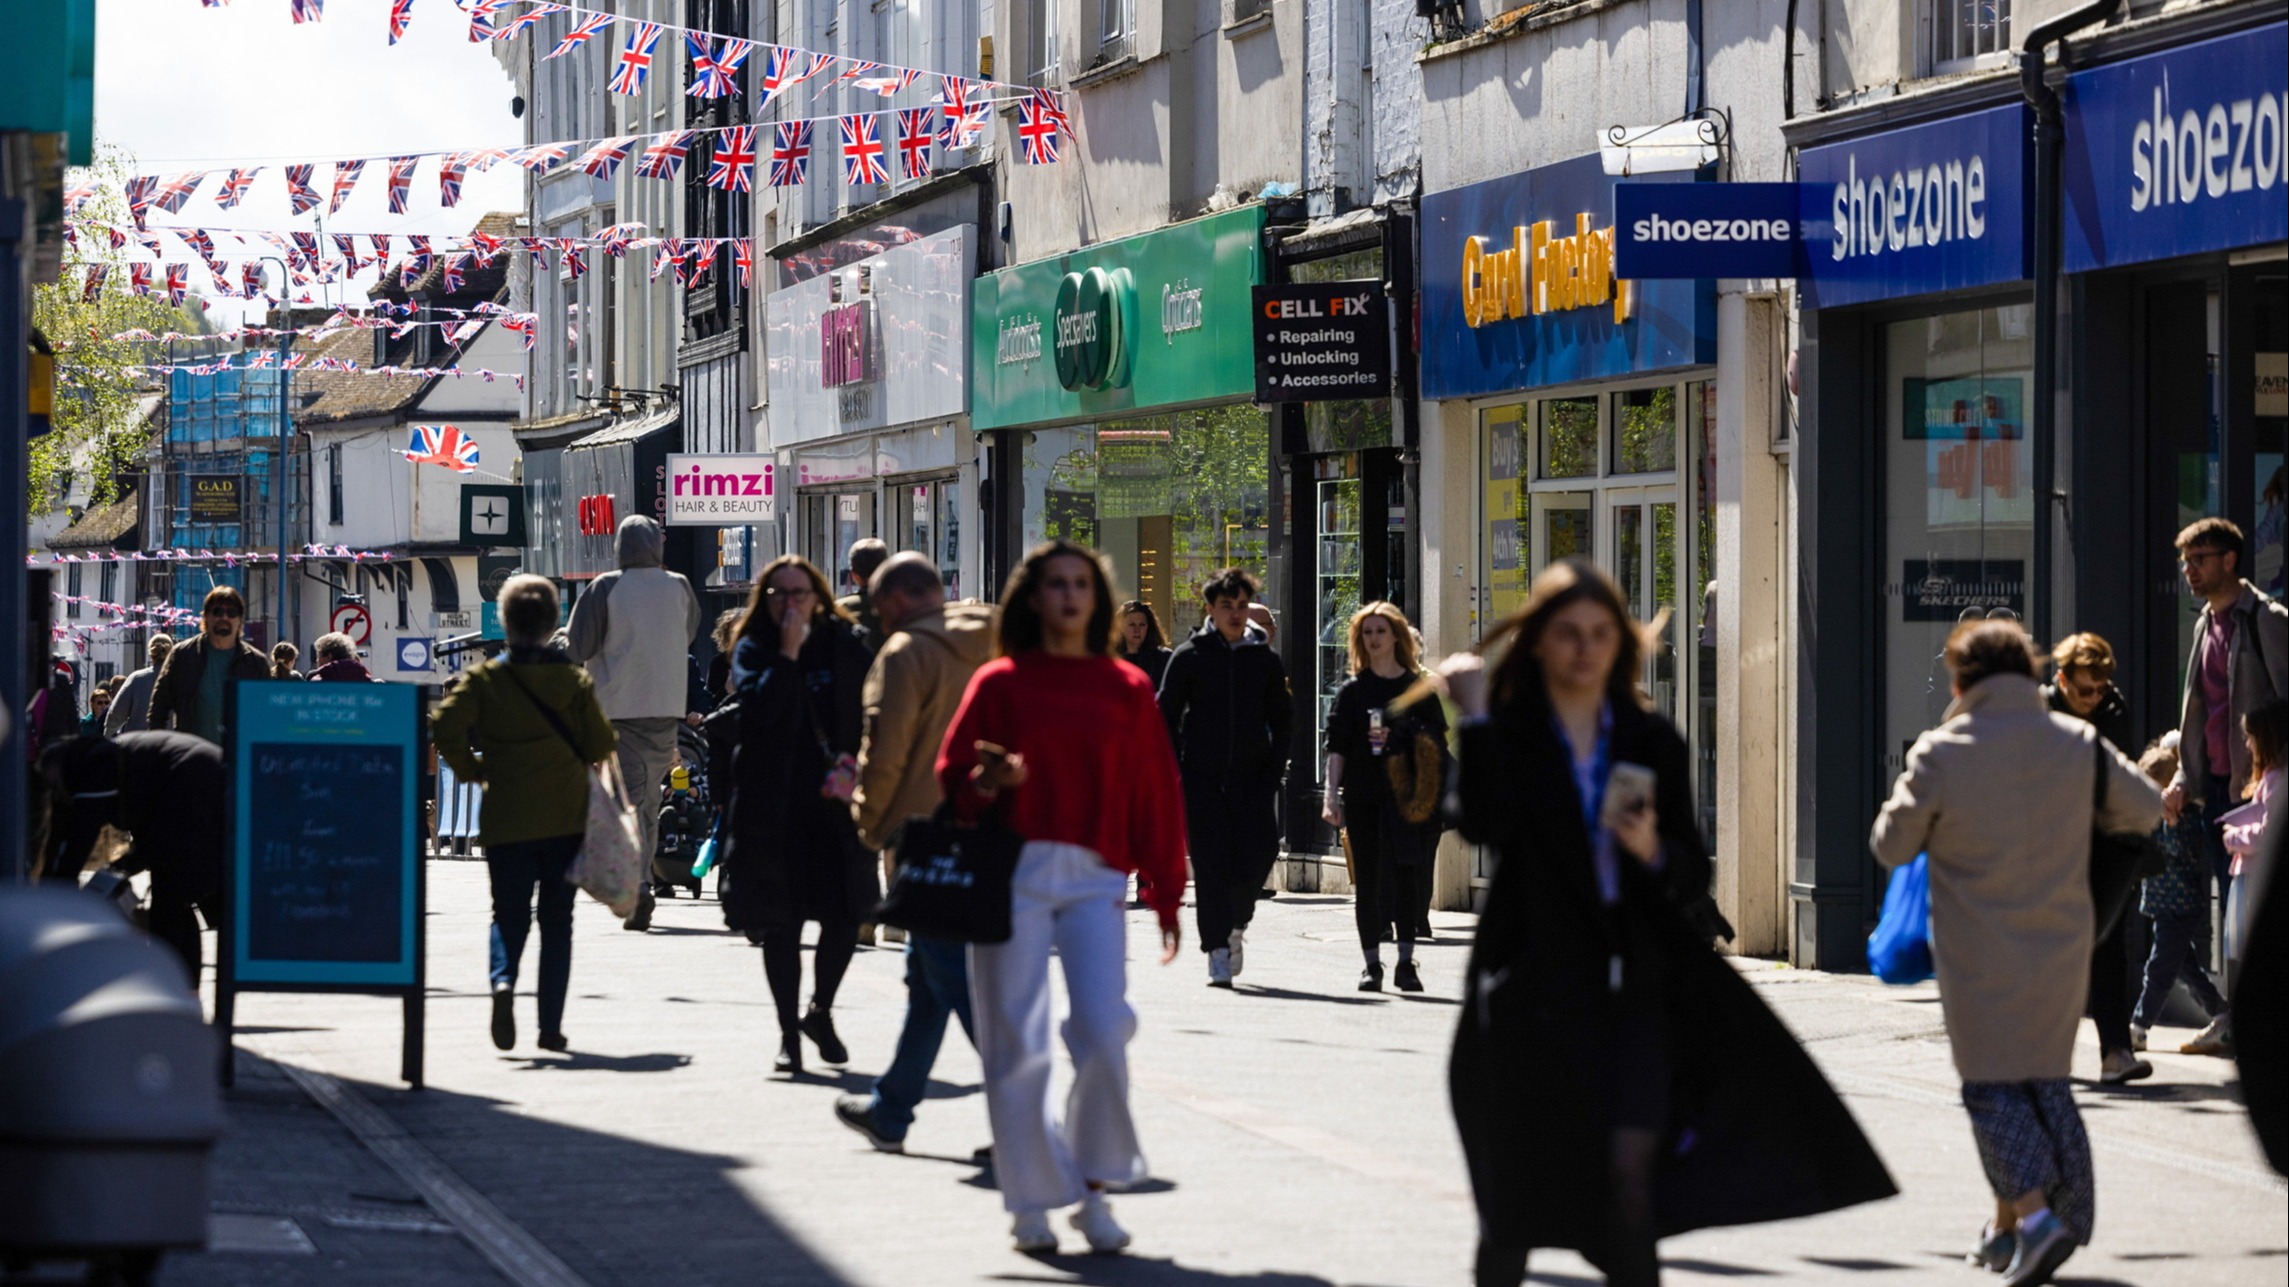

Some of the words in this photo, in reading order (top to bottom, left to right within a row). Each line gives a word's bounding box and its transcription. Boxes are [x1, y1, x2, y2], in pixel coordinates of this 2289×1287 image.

[1831, 153, 1985, 262] shoezone
[1633, 213, 1790, 241] shoezone
[1462, 226, 1528, 328] Card
[1264, 299, 1324, 319] CELL
[1056, 308, 1097, 358] Specsavers
[1280, 329, 1355, 346] Repairing
[1281, 350, 1359, 366] Unlocking
[1281, 371, 1378, 388] Accessories
[1492, 431, 1511, 476] Buy
[674, 464, 773, 496] rimzi
[675, 501, 705, 513] HAIR
[710, 501, 719, 513] &
[723, 501, 773, 513] BEAUTY
[1492, 531, 1508, 561] 4th
[1919, 596, 2011, 606] SKECHERS
[442, 617, 469, 626] STREET
